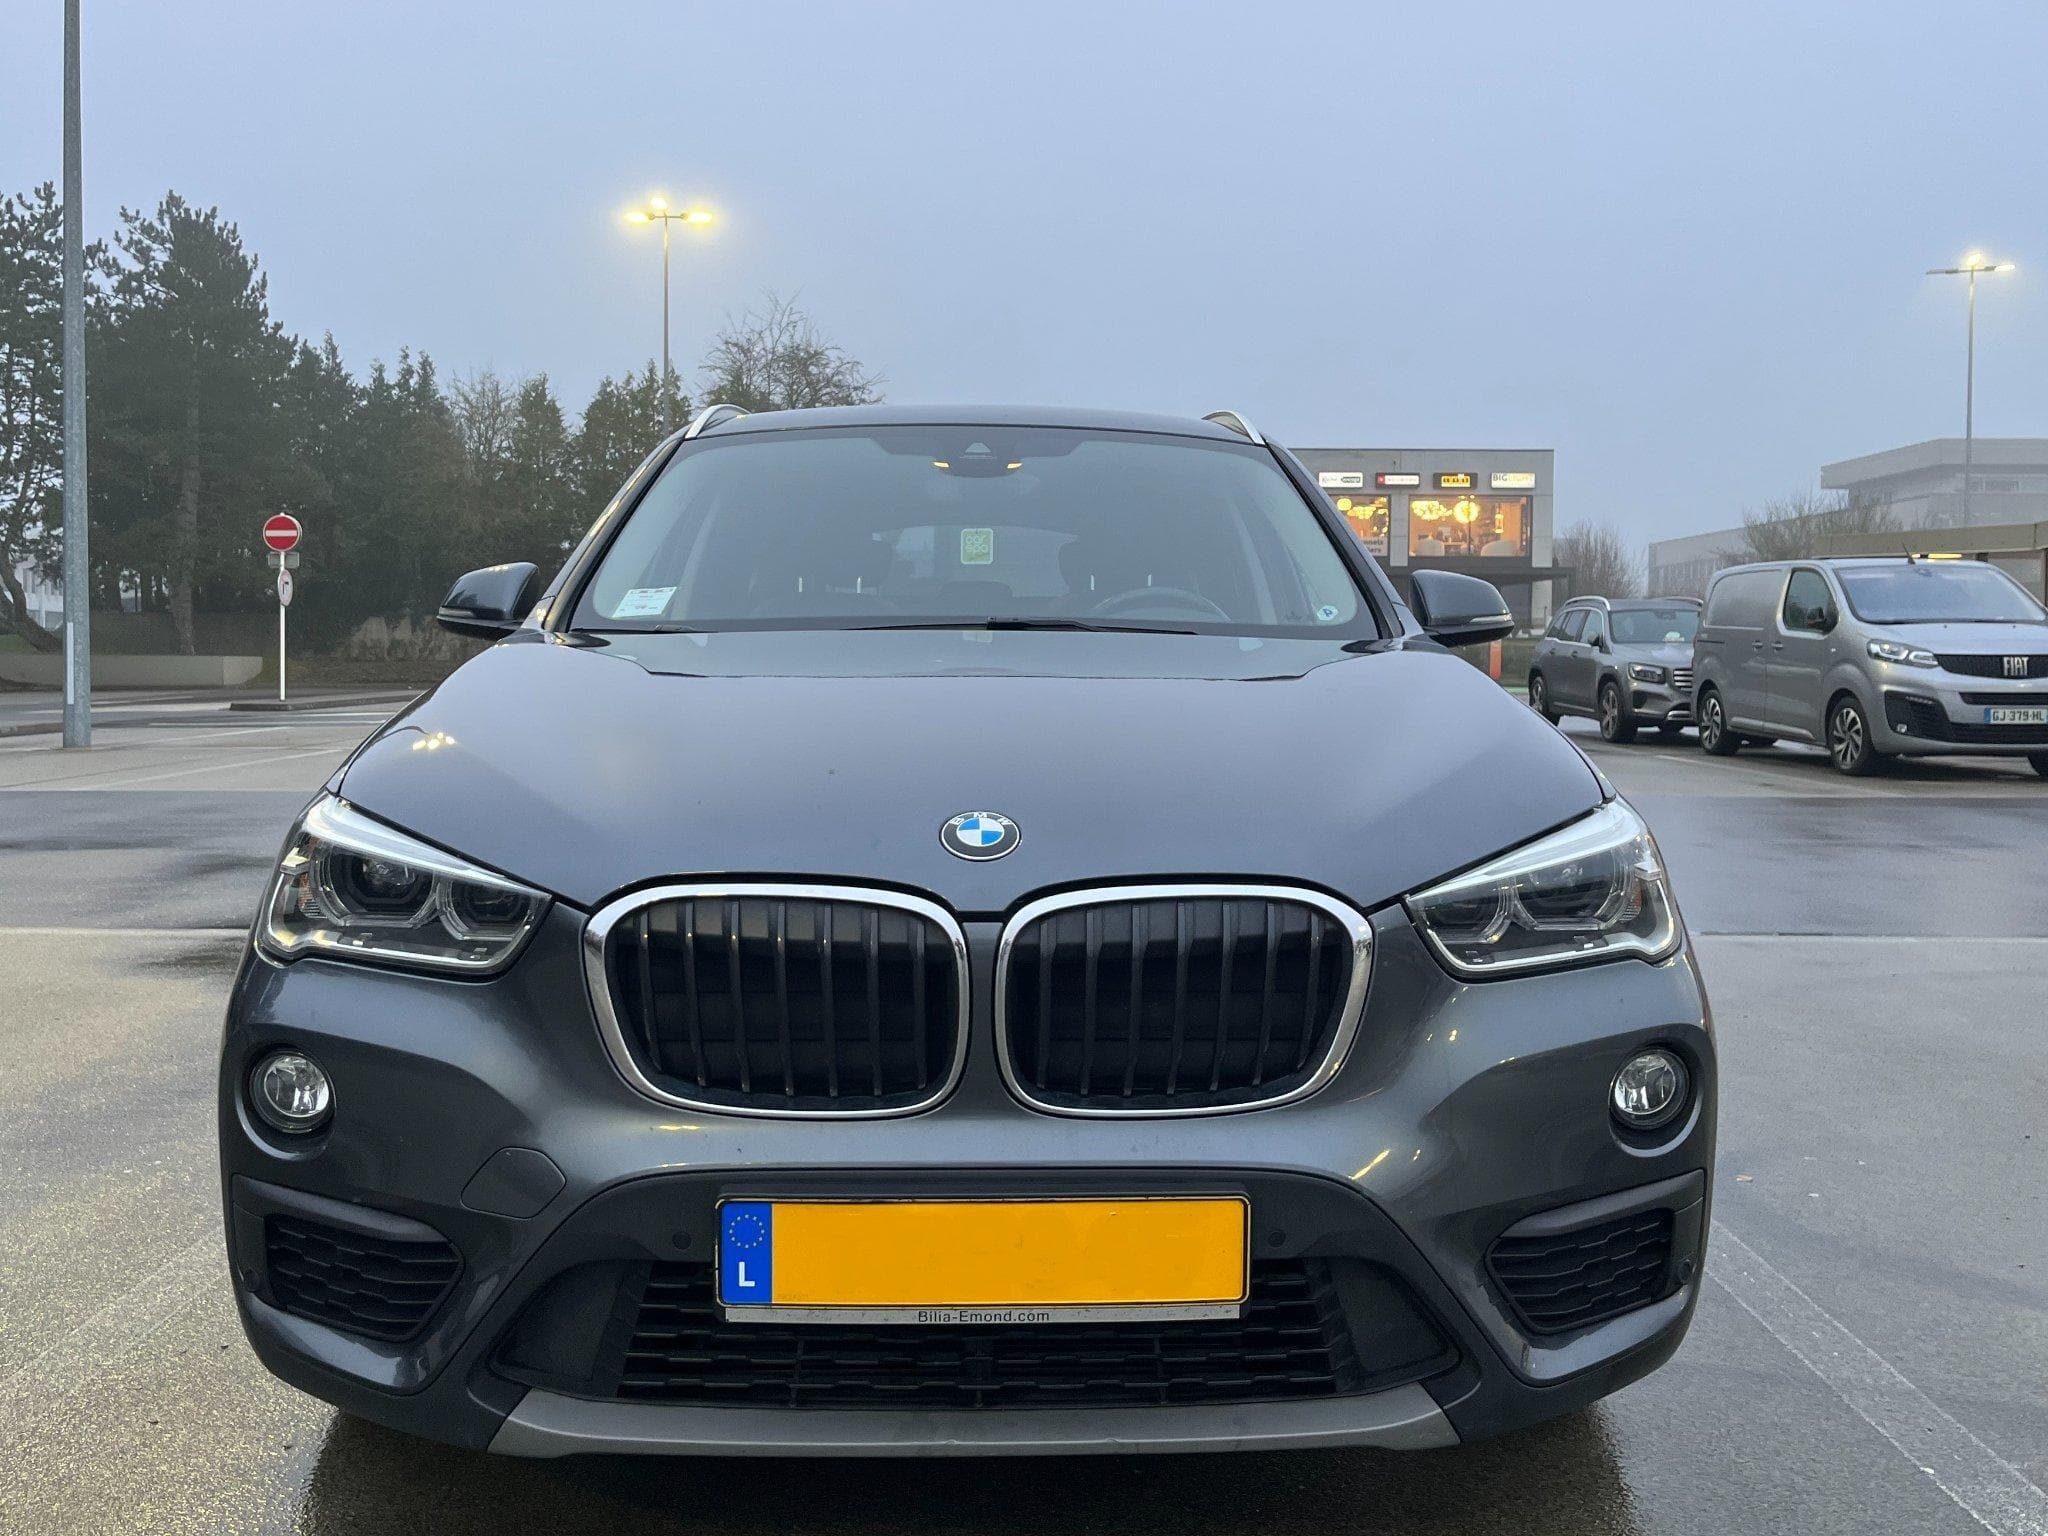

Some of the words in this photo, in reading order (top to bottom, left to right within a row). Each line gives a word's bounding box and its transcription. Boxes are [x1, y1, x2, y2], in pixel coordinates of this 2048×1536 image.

[2003, 656, 2029, 676] FIAT
[948, 811, 1015, 826] BMW
[738, 1261, 756, 1287] L
[918, 1310, 1050, 1323] Bilia-Emond.com
